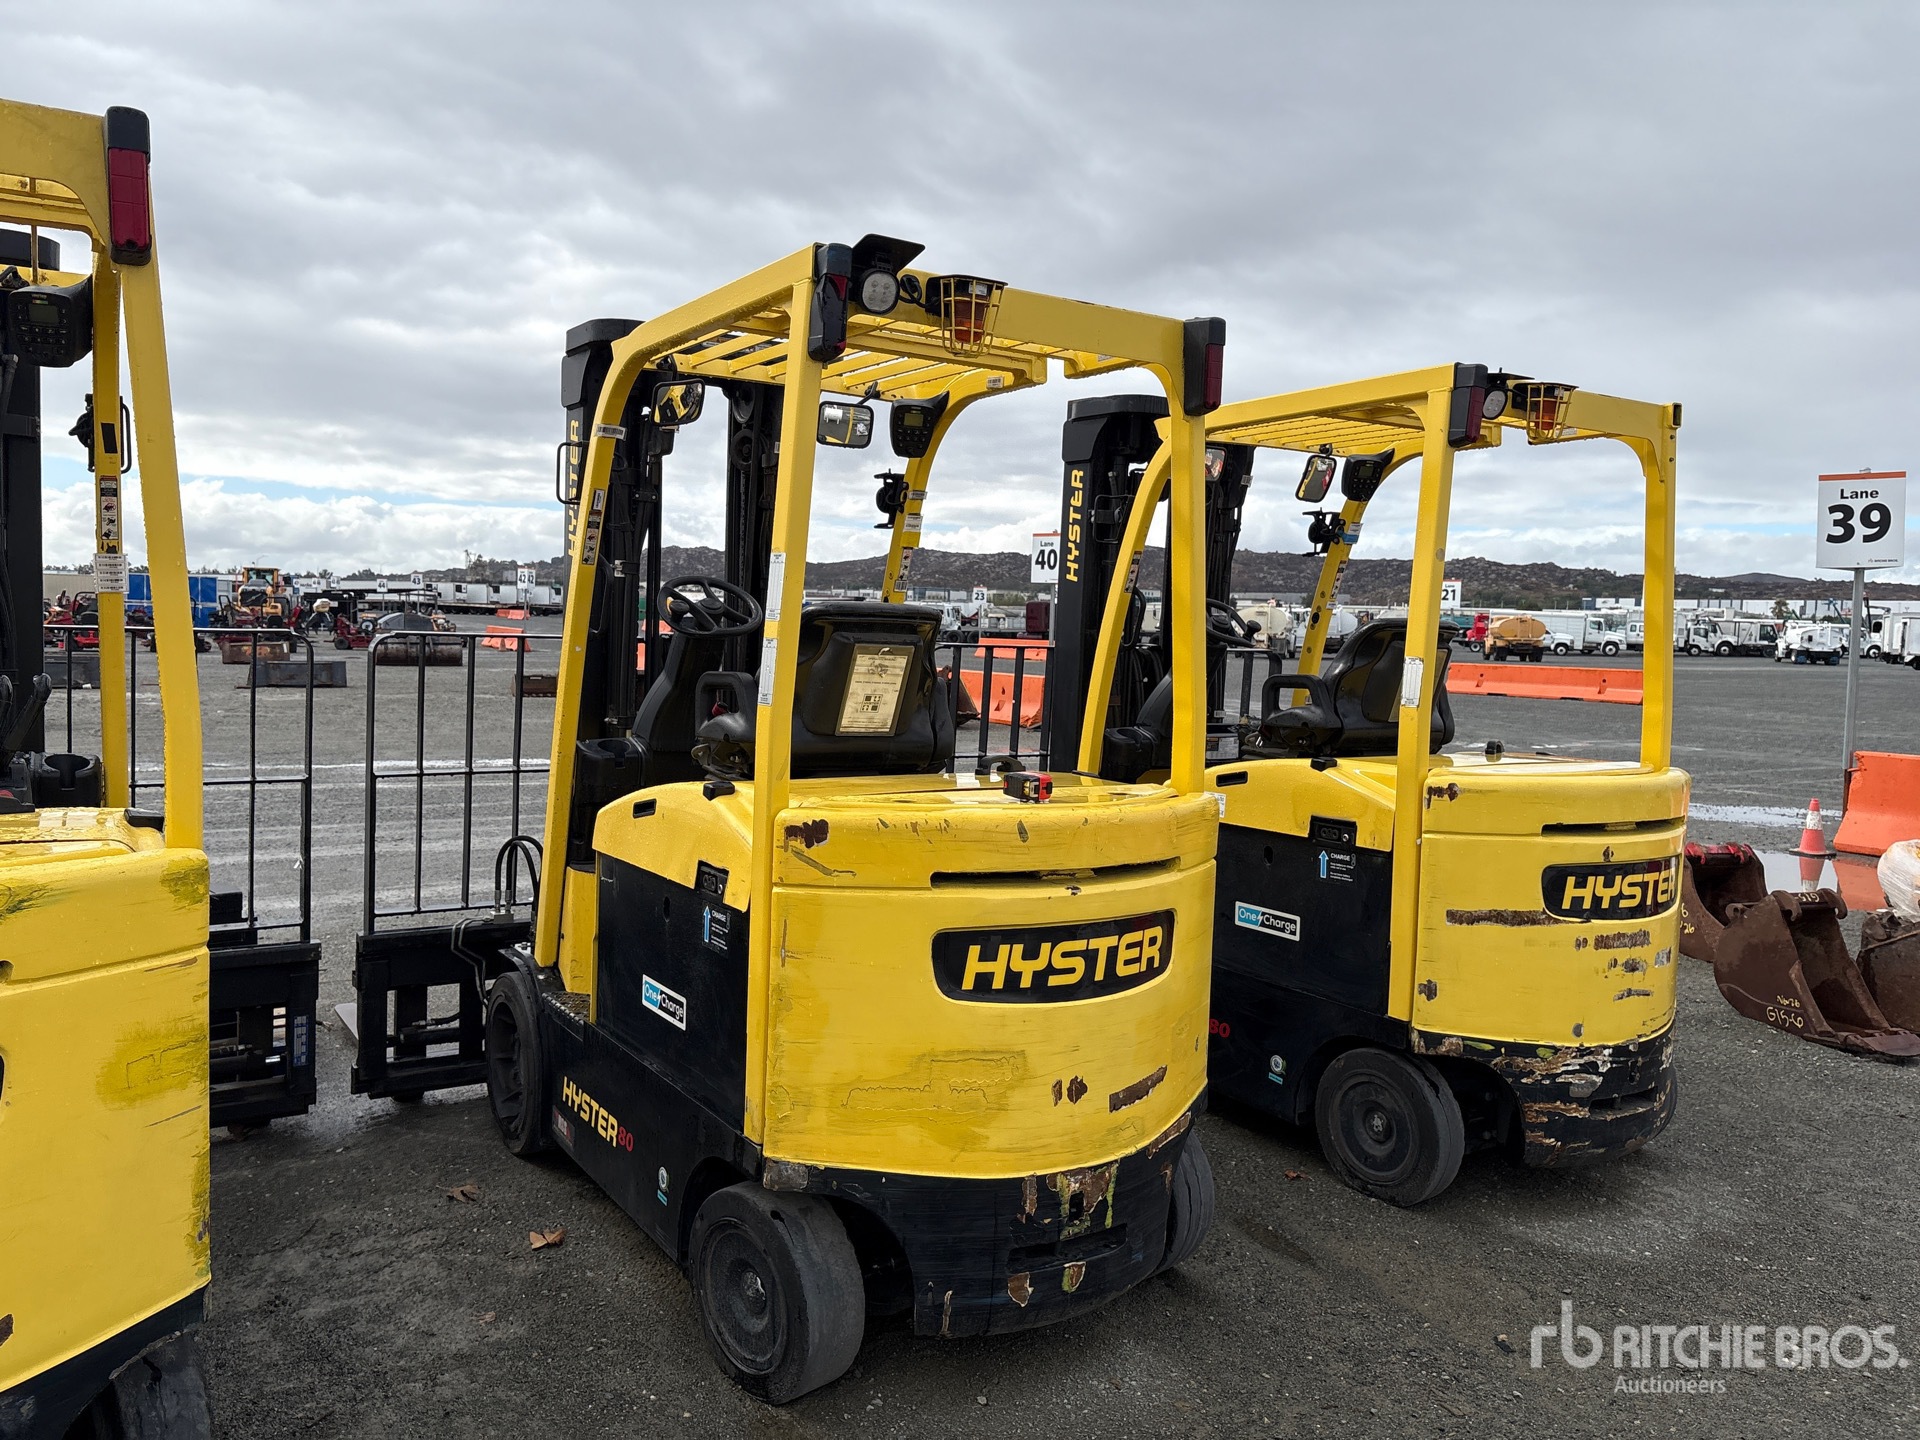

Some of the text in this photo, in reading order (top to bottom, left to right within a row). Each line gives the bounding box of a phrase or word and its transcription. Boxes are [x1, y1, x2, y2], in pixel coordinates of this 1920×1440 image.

[1840, 488, 1879, 499] Lane
[1066, 469, 1084, 582] HYSTER
[1826, 503, 1891, 544] 39
[1035, 549, 1058, 570] 40
[412, 577, 421, 585] 43
[519, 574, 526, 583] 42
[974, 592, 985, 600] 23
[1441, 589, 1456, 601] 21
[1561, 867, 1676, 910] HYSTER
[961, 925, 1164, 991] HYSTER
[562, 1075, 618, 1148] HYSTER
